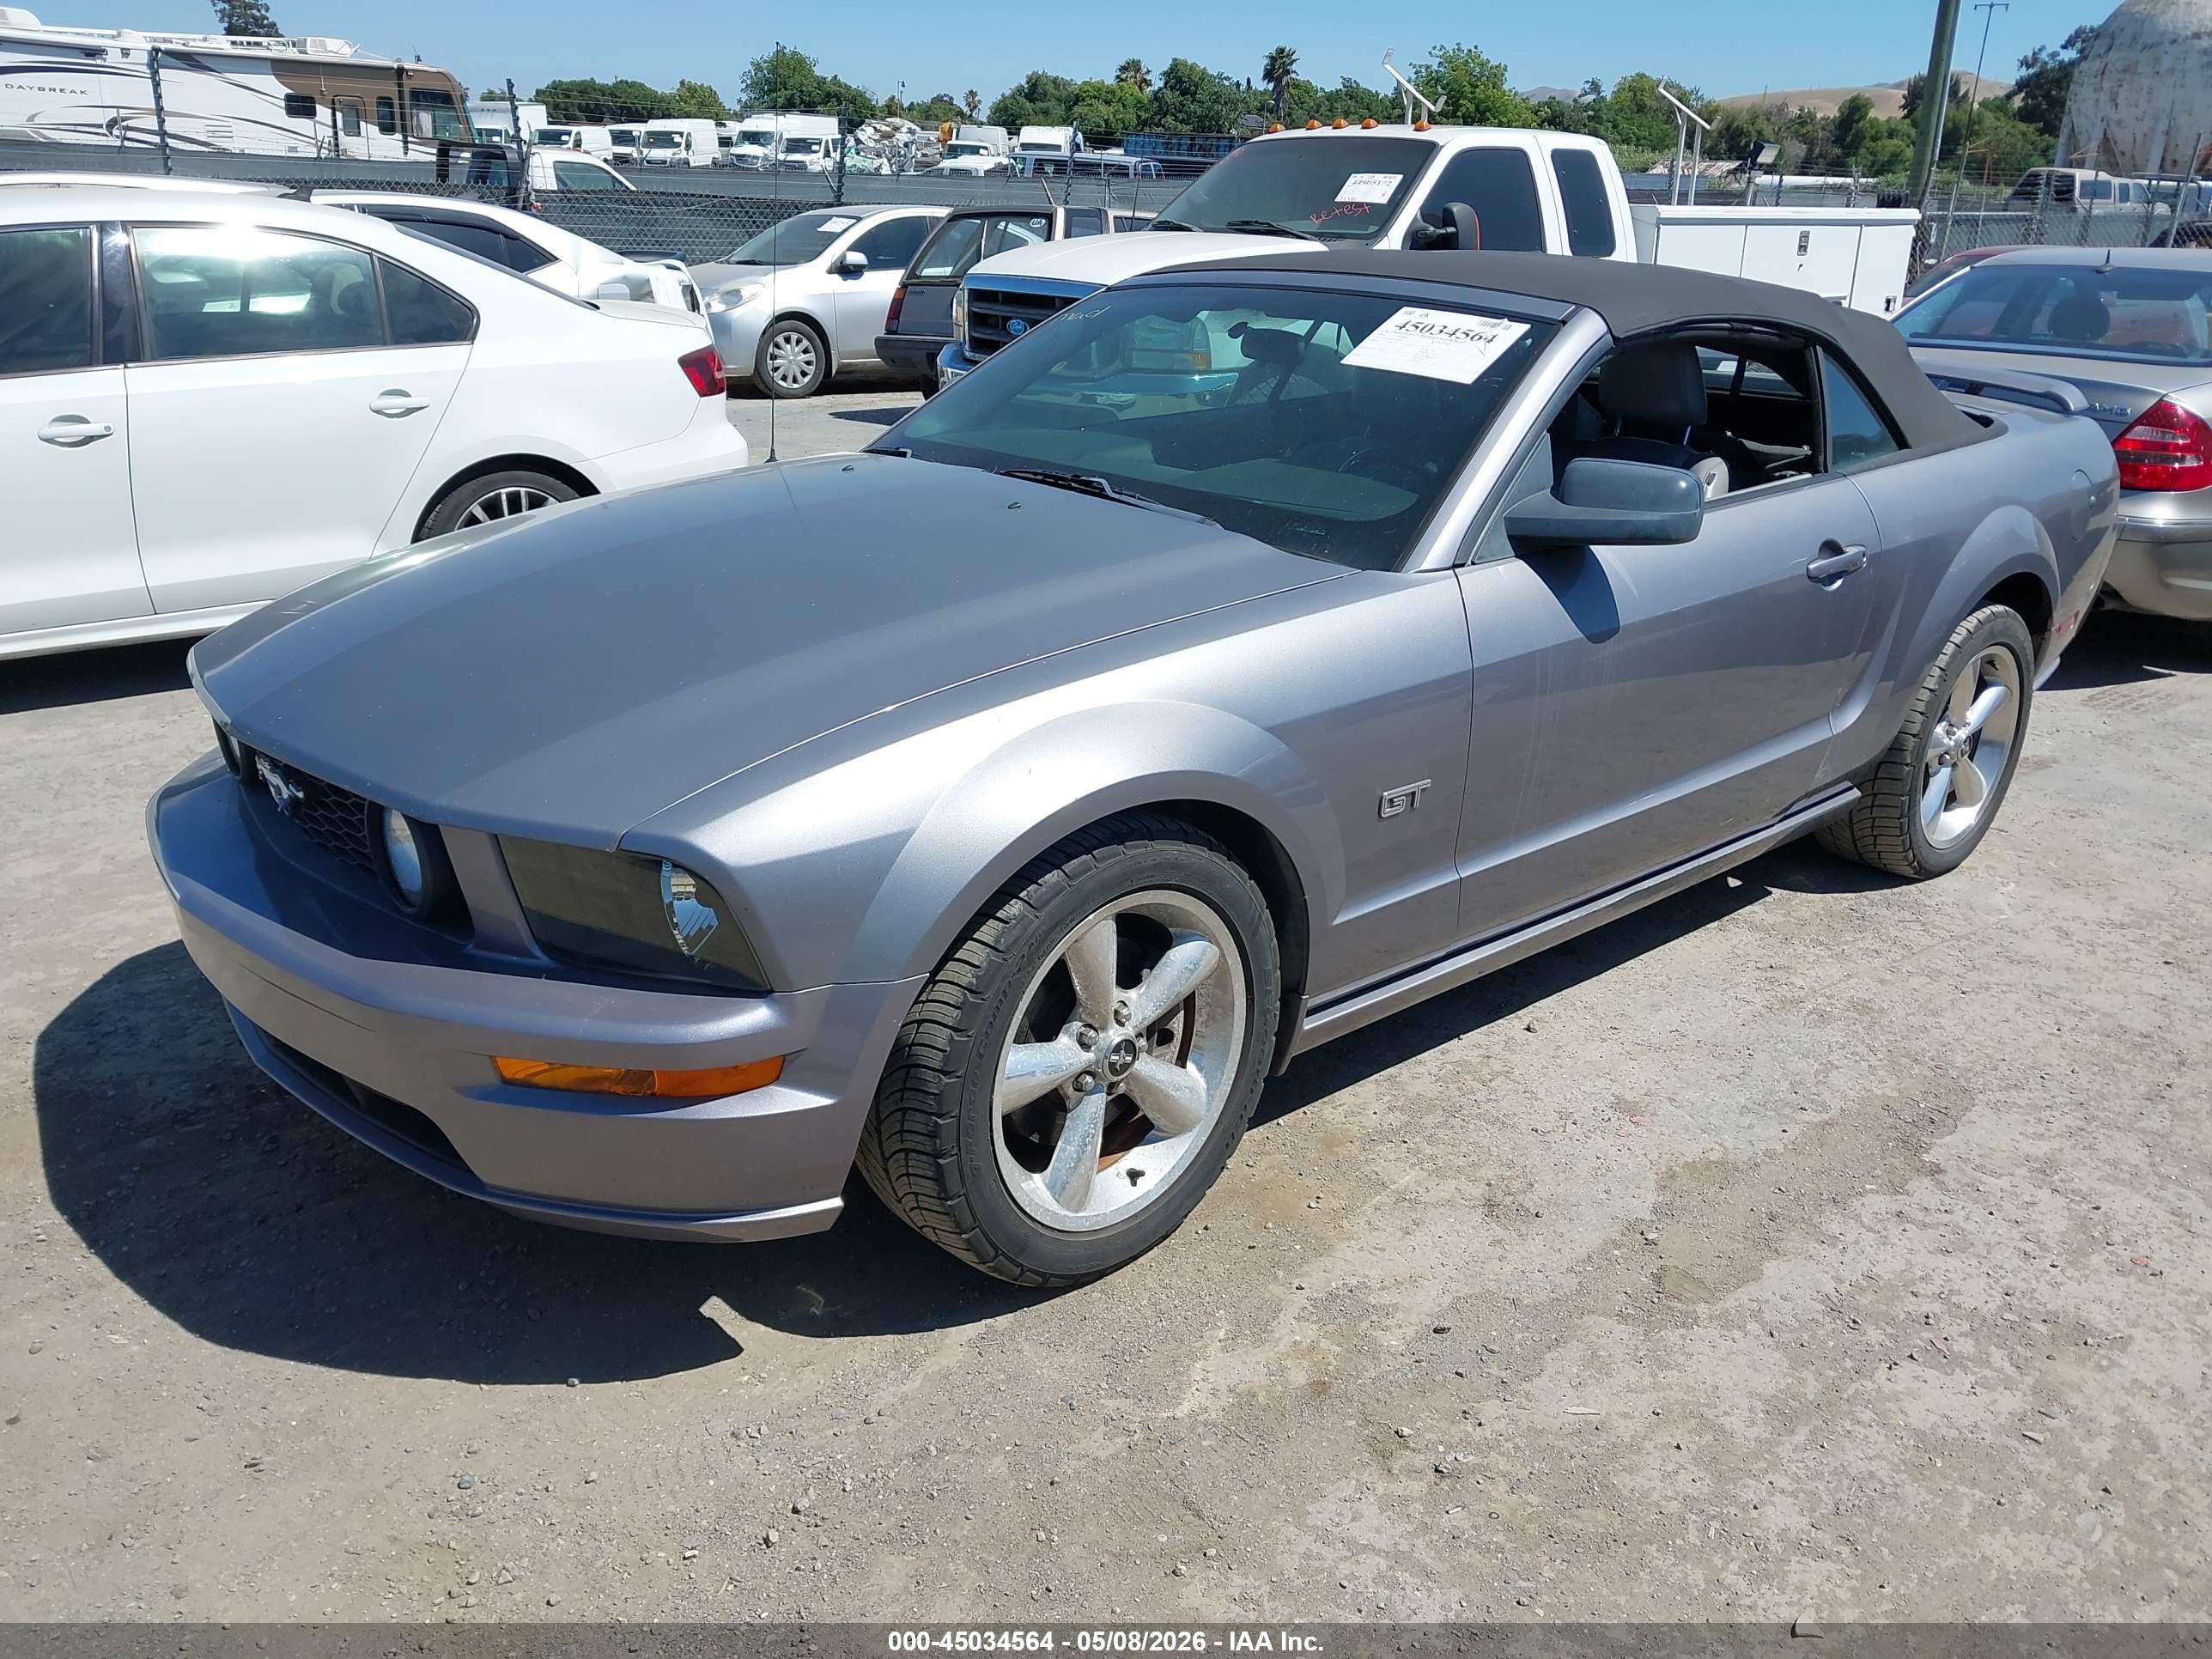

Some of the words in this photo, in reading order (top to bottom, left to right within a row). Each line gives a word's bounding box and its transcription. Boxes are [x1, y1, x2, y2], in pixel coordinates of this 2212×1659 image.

[5, 83, 88, 94] DAYBREAK
[1395, 319, 1498, 343] 45034564
[1379, 778, 1432, 818] GT
